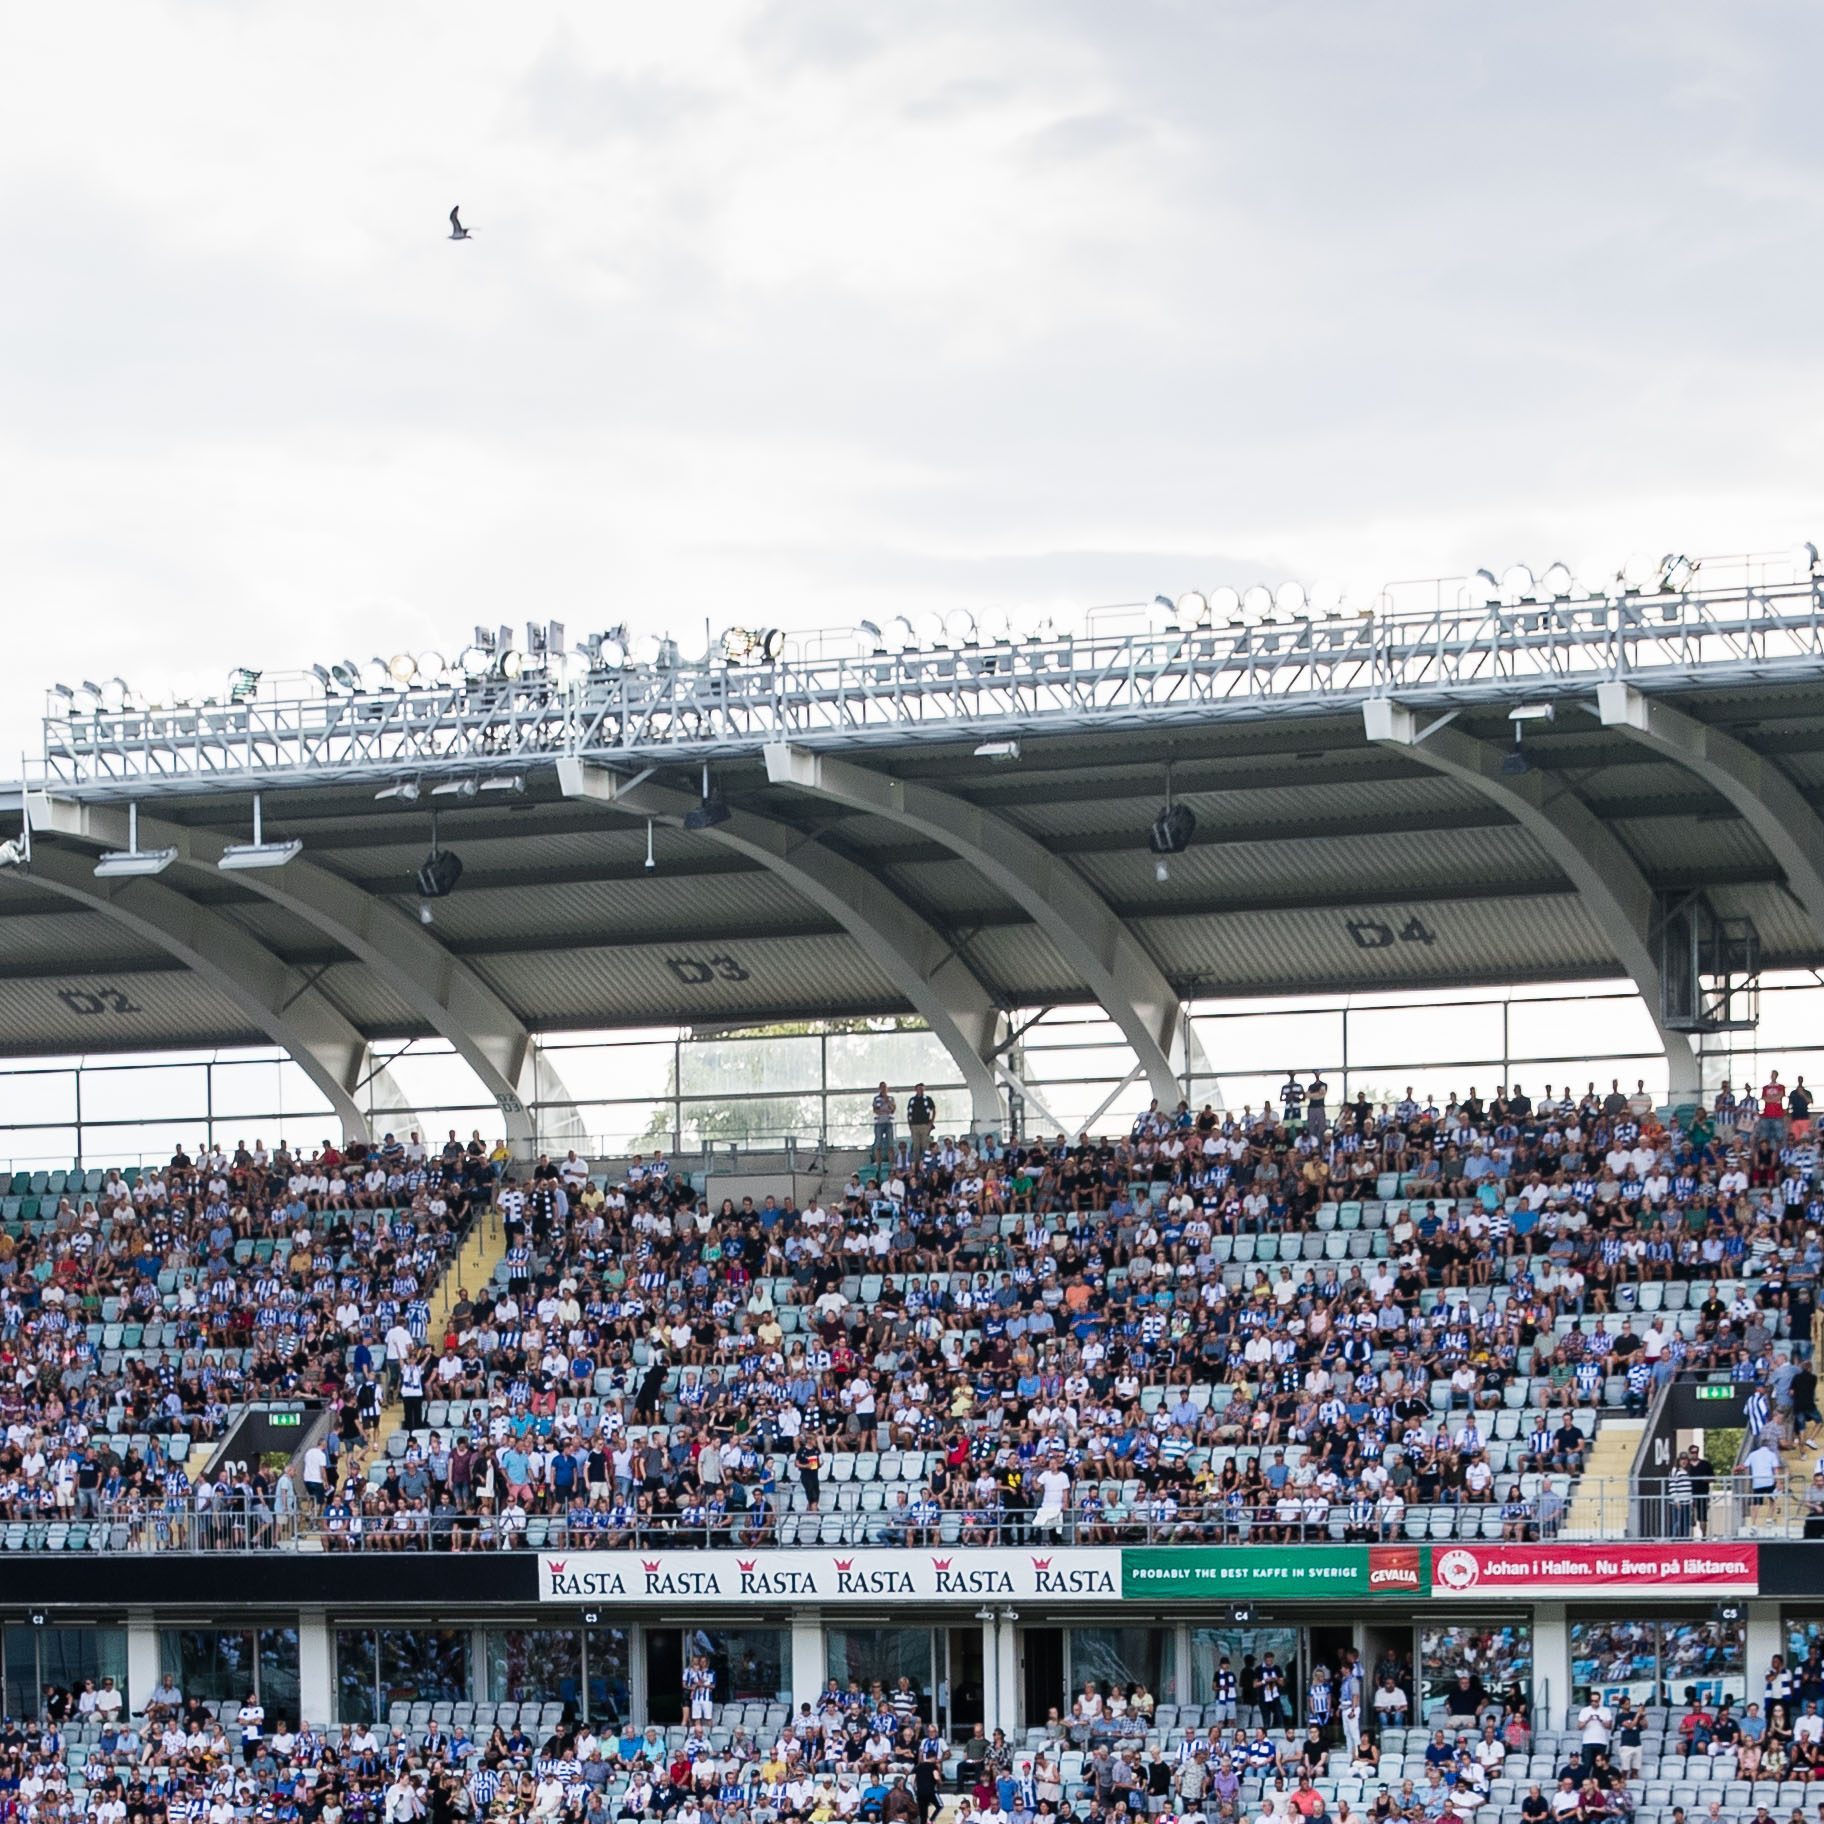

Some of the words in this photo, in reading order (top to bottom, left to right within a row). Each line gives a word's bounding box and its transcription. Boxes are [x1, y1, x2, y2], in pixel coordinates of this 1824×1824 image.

[1346, 917, 1438, 950] D4
[665, 955, 752, 987] D3
[59, 988, 143, 1016] D2
[1655, 1438, 1670, 1465] D4
[1132, 1567, 1190, 1580] PROBABLY
[1194, 1567, 1215, 1580] THE
[1219, 1567, 1248, 1580] BEST
[1252, 1567, 1287, 1579] KAFFE
[1291, 1567, 1304, 1579] IN
[1307, 1566, 1358, 1580] SVERIGE
[1370, 1566, 1418, 1586] GEVALIA
[1482, 1559, 1526, 1577] Johan
[1531, 1560, 1537, 1576] i
[1541, 1560, 1592, 1576] Hallen.
[1596, 1559, 1618, 1576] Nu
[1621, 1559, 1655, 1576] även
[1658, 1559, 1680, 1580] på
[1683, 1559, 1749, 1575] läktaren.
[552, 1573, 626, 1594] RASTA
[645, 1573, 721, 1595] RASTA
[740, 1572, 818, 1594] RASTA
[837, 1572, 915, 1593] RASTA
[935, 1571, 1014, 1592] RASTA
[1035, 1570, 1115, 1592] RASTA
[33, 1616, 43, 1624] C2
[586, 1614, 597, 1622] C3
[1235, 1612, 1248, 1620] C4
[1723, 1609, 1737, 1618] C5
